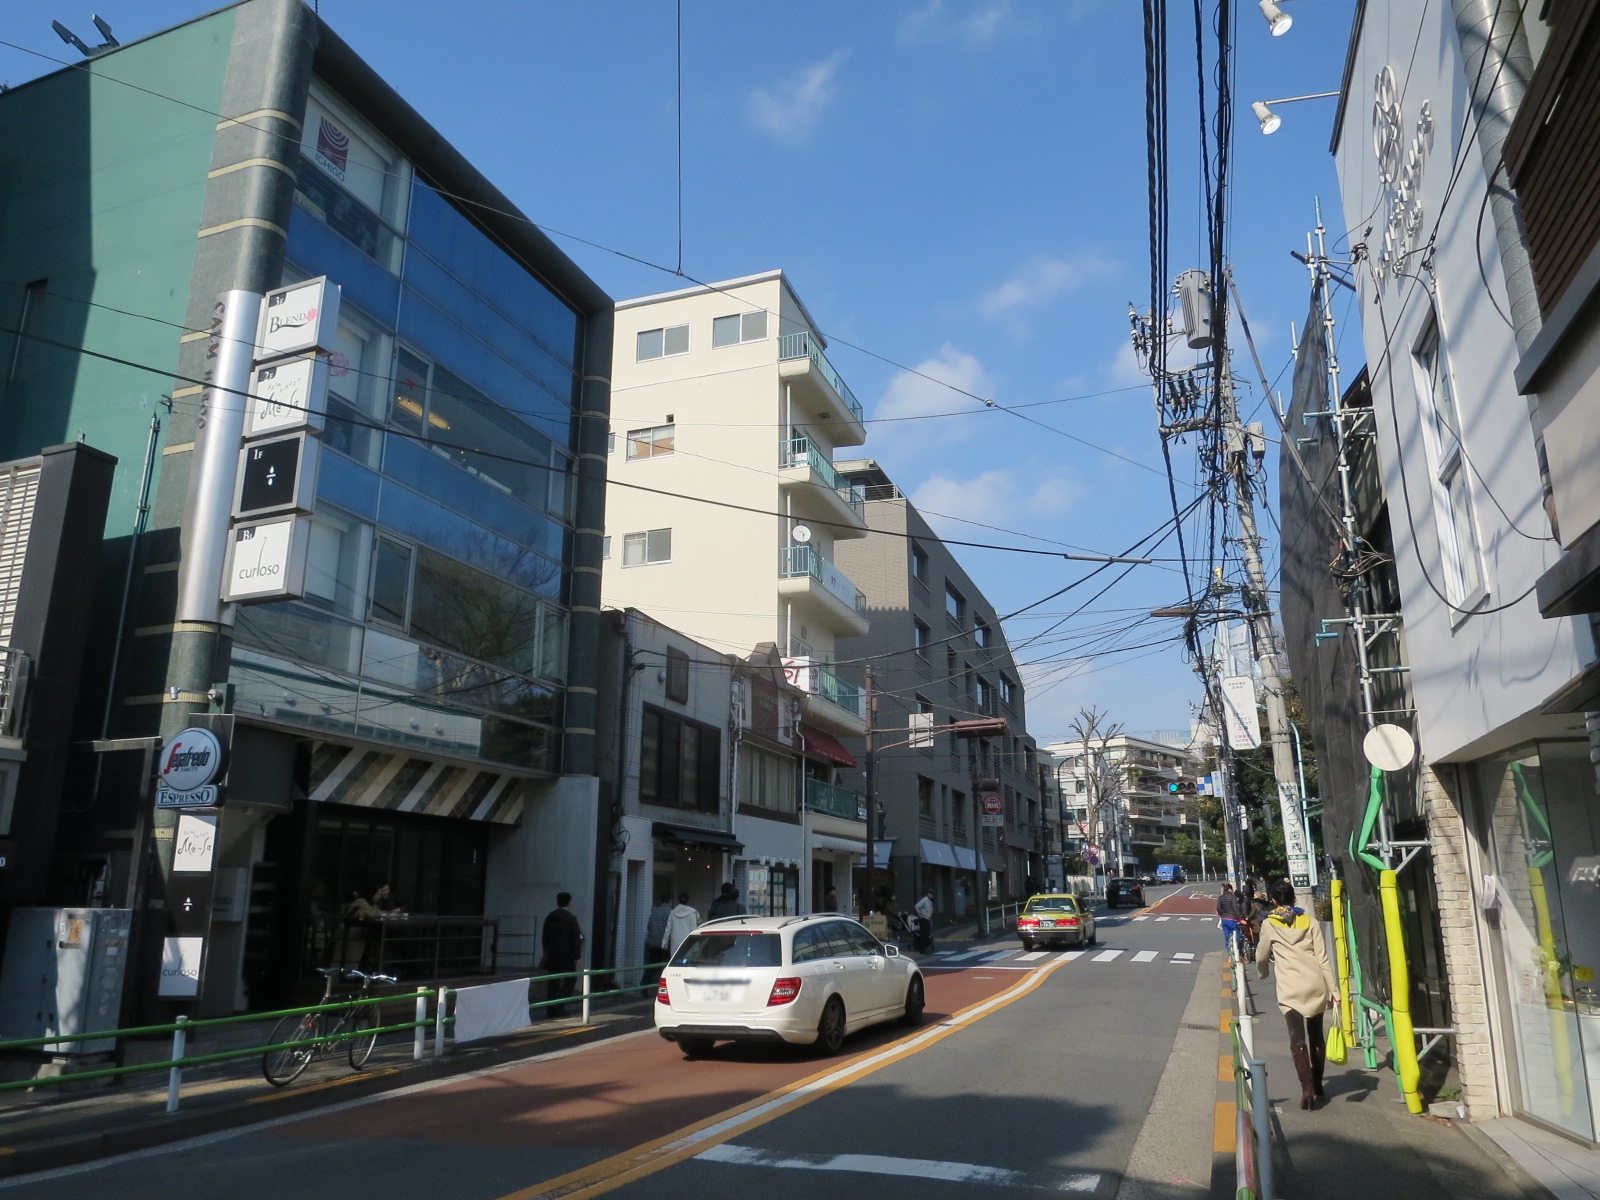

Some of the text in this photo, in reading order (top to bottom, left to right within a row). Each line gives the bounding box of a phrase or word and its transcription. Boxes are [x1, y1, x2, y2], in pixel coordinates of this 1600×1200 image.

[316, 153, 345, 181] ICHIGO
[275, 296, 285, 306] 3F
[269, 312, 306, 334] BLEND
[264, 371, 274, 381] 2F
[253, 449, 263, 460] 1F
[238, 536, 280, 579] curioso
[163, 742, 211, 775] Segafredo
[160, 789, 210, 804] ESPRESSO
[1284, 794, 1303, 853] オクマ歯科
[162, 950, 198, 977] curioso
